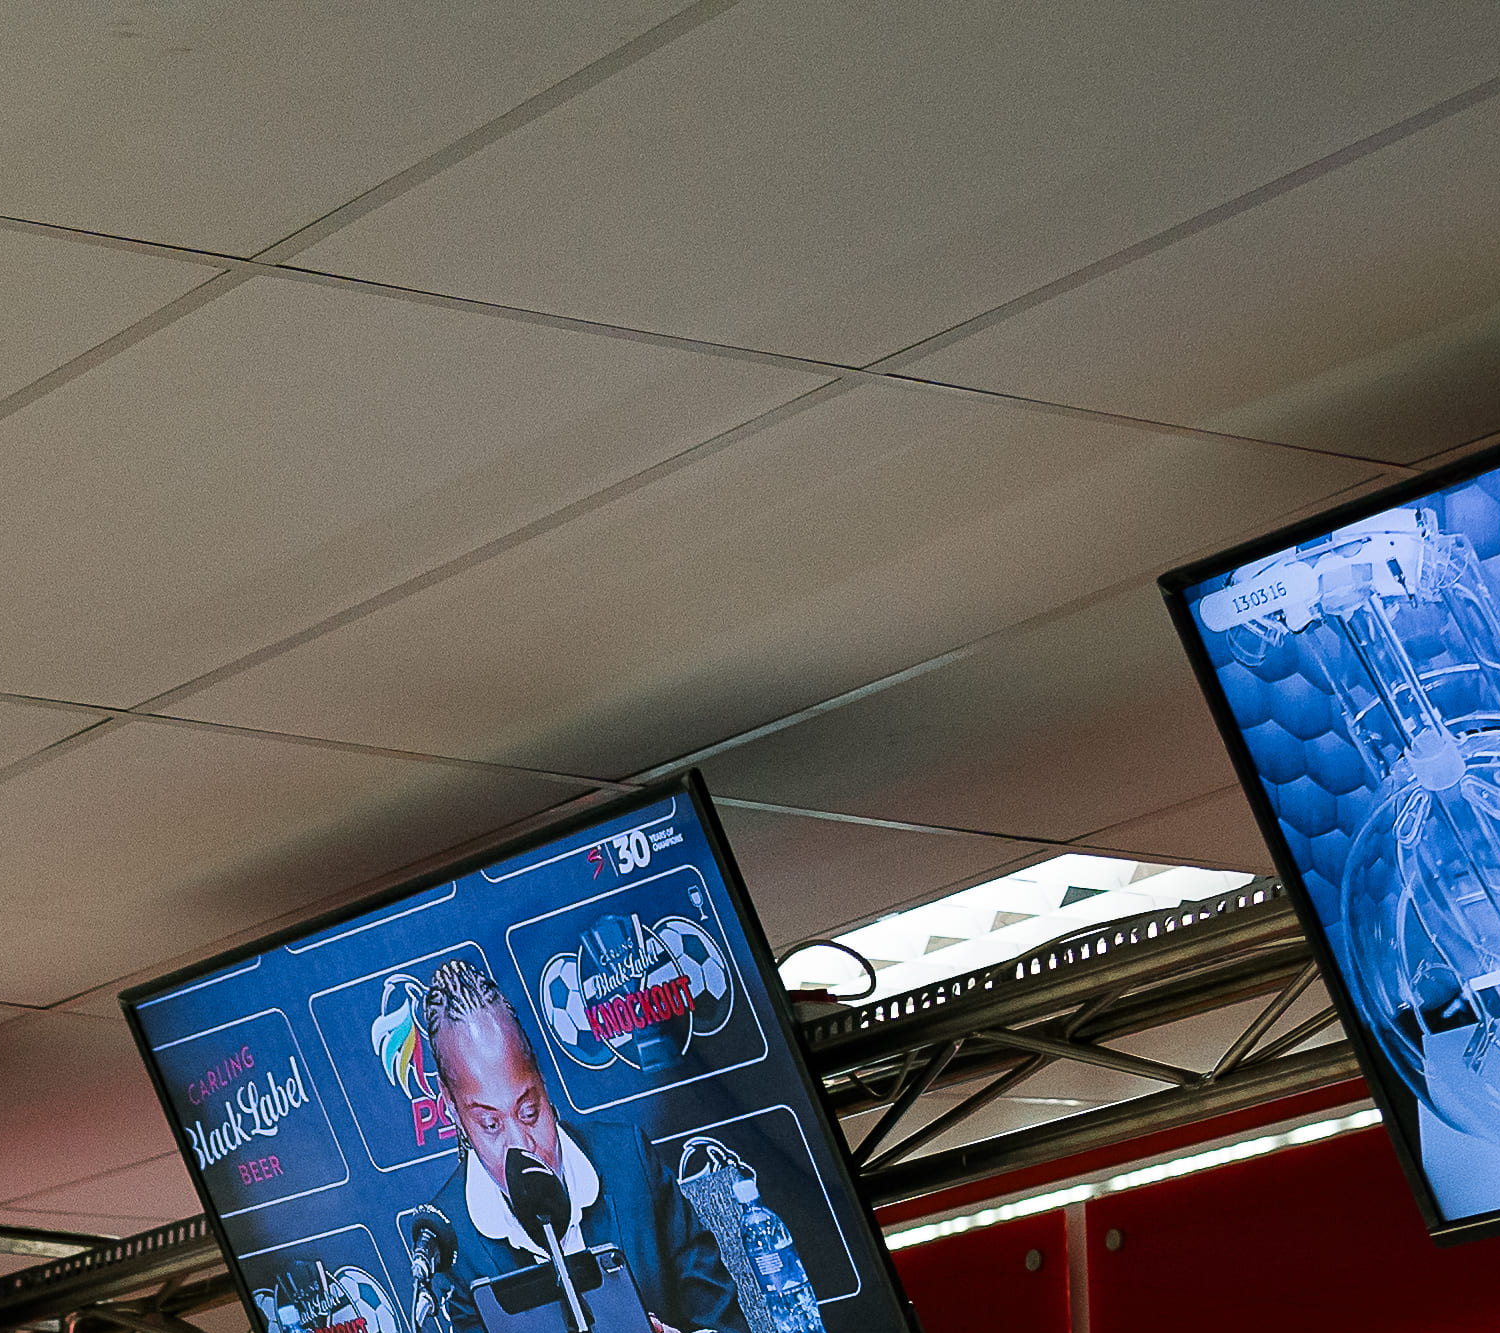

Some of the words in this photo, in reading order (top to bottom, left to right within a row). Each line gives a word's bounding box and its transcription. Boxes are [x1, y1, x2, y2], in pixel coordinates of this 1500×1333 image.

[612, 830, 651, 874] 30
[593, 960, 630, 999] Black
[586, 974, 695, 1042] KNOCKOUT
[188, 1046, 254, 1105] CARLING
[236, 1055, 309, 1136] Label
[238, 1154, 284, 1185] BEER
